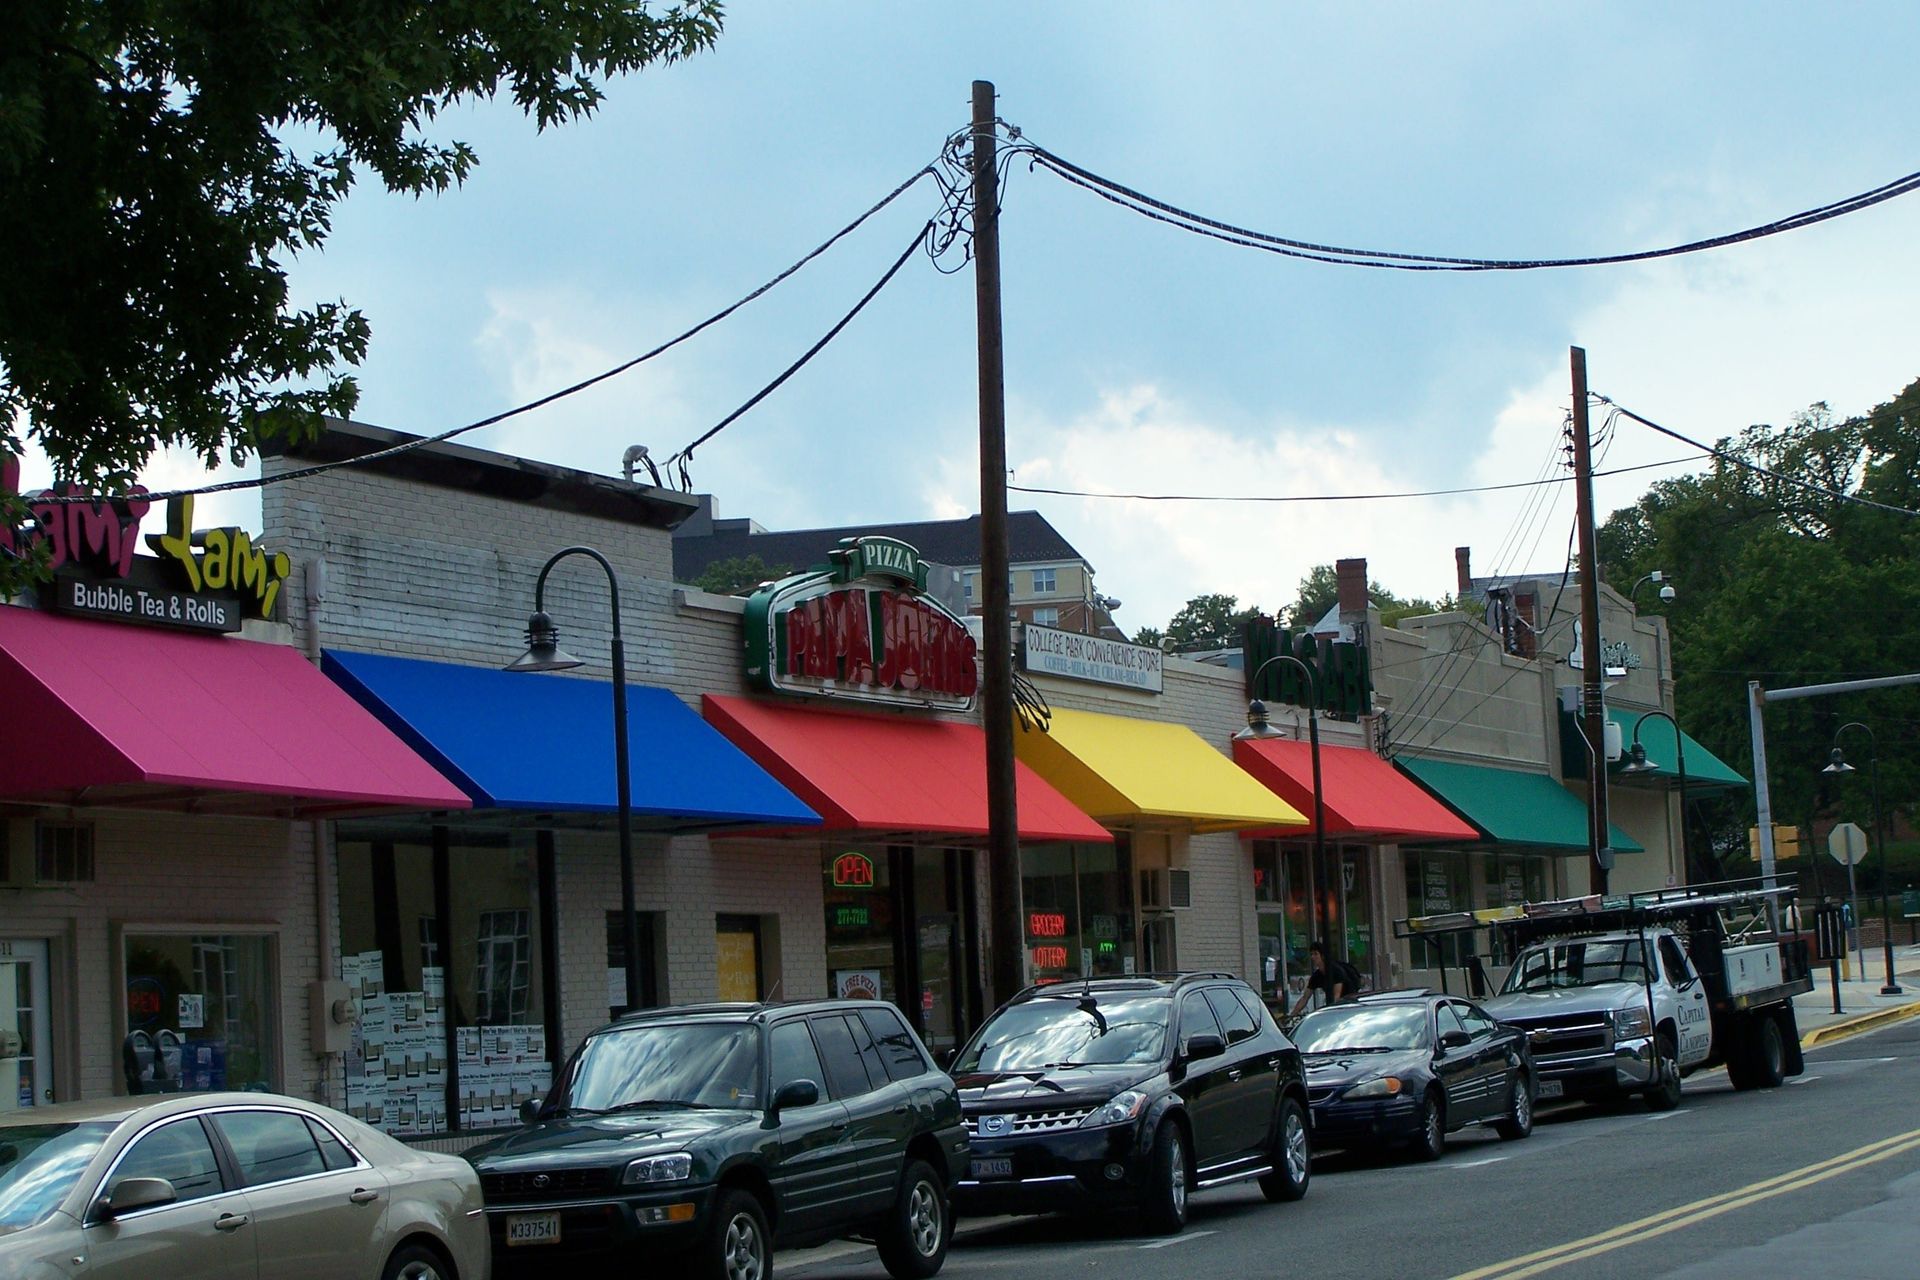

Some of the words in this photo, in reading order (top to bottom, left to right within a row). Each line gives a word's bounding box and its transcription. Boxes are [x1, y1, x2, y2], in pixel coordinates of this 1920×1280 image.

[865, 545, 914, 573] PIZZA
[74, 582, 133, 613] Bubble
[138, 591, 165, 617] Tea
[169, 596, 181, 619] &
[186, 598, 225, 625] Rolls
[787, 589, 874, 686] PAPA
[1028, 628, 1064, 655] COLLEGE
[1065, 636, 1085, 658] PARK
[1086, 640, 1136, 668] CONVENIENCE
[1138, 649, 1160, 672] STORE
[1246, 620, 1372, 720] WASABI
[836, 856, 872, 884] OPEN
[1030, 914, 1065, 936] GROCERY
[1032, 946, 1067, 968] LOTTERY
[845, 974, 861, 991] FREE
[860, 975, 878, 996] PIZZA
[127, 991, 162, 1014] PEN
[1677, 1005, 1706, 1026] CAPITAL
[511, 1220, 557, 1238] M337541
